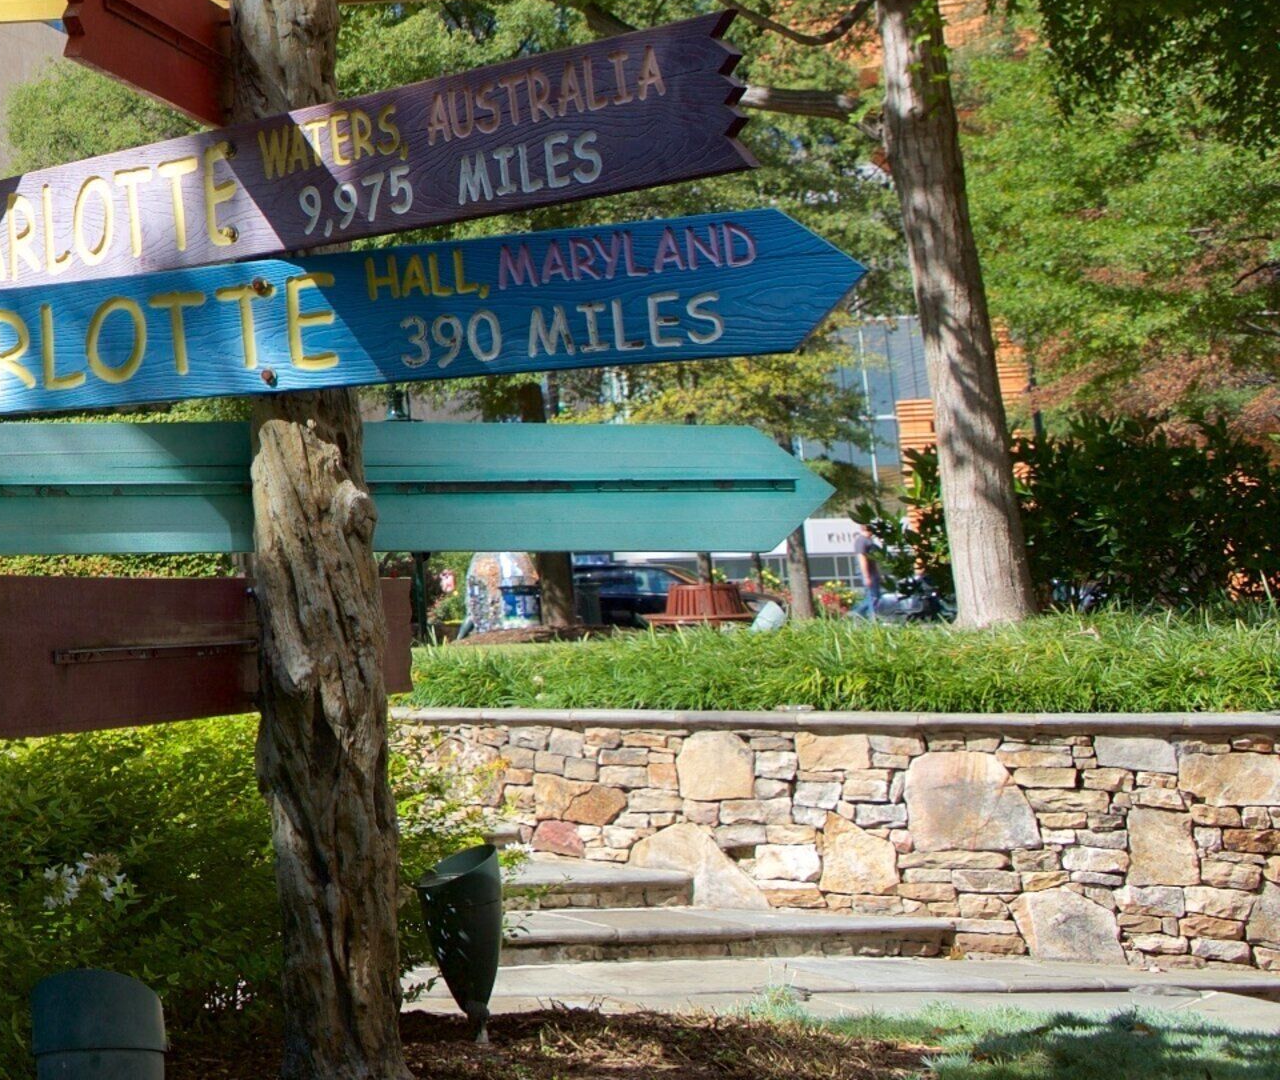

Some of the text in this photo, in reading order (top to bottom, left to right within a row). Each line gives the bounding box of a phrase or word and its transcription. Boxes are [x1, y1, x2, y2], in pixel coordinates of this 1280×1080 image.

[258, 104, 409, 180] WATERS,
[426, 44, 667, 147] AUSTRALIA
[298, 130, 603, 238] 9,975 MILES
[364, 248, 490, 301] HALL,
[498, 220, 758, 290] MARYLAND
[399, 290, 725, 369] 390 MILES
